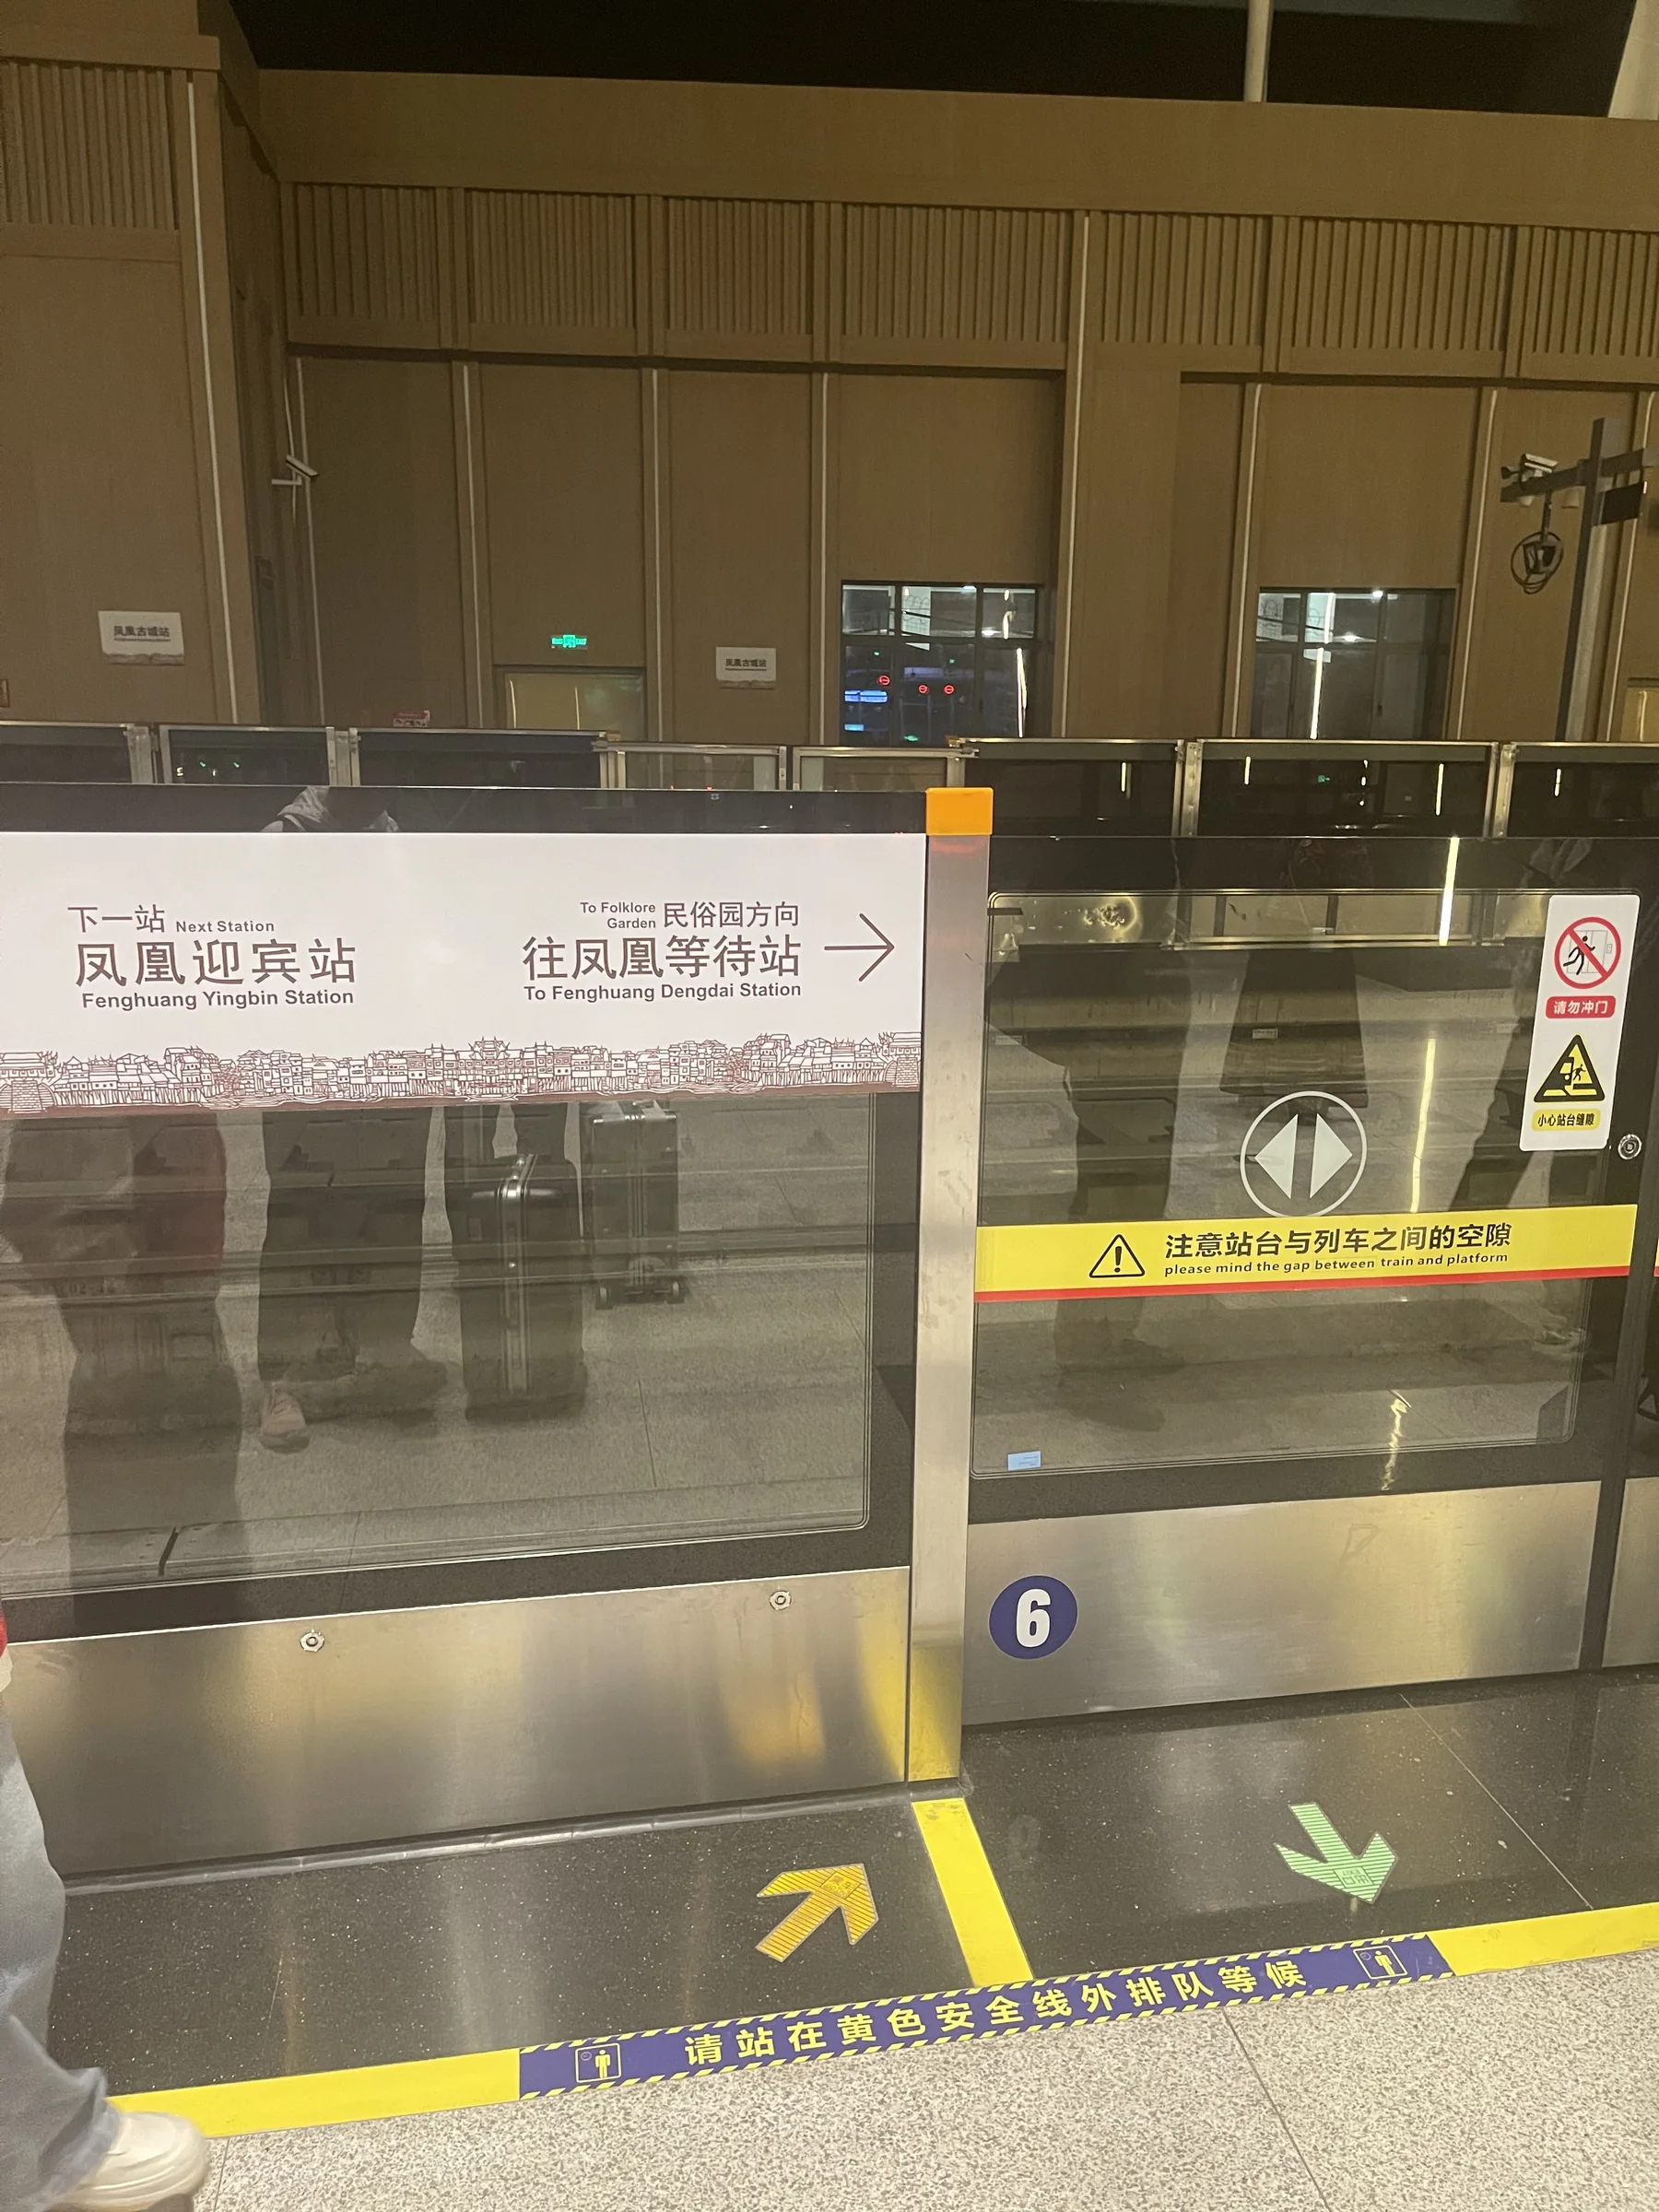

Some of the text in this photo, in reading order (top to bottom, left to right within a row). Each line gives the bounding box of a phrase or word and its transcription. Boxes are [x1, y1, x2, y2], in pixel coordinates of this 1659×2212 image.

[67, 904, 166, 933] 下一站
[580, 901, 656, 913] To Folklore
[663, 900, 800, 928] 民俗园方向
[175, 920, 275, 933] Next Station
[606, 918, 656, 929] Garden
[76, 937, 356, 986] 凤凰迎宾站
[523, 934, 802, 981] 往凤凰等待站
[82, 989, 354, 1011] Fenghuang Yingbin Station
[524, 982, 801, 1004] To Fenghuang Dengdai Station
[1553, 1000, 1608, 1015] 请勿冲门
[1537, 1112, 1595, 1127] 小心站台缝隙
[1165, 1222, 1512, 1259] 注意站台与列车之间的空隙
[1165, 1253, 1508, 1277] please mind the gap between train and platform
[1016, 1588, 1052, 1648] 6
[684, 1960, 1307, 2066] 请站在黄色安全线外排队等候
